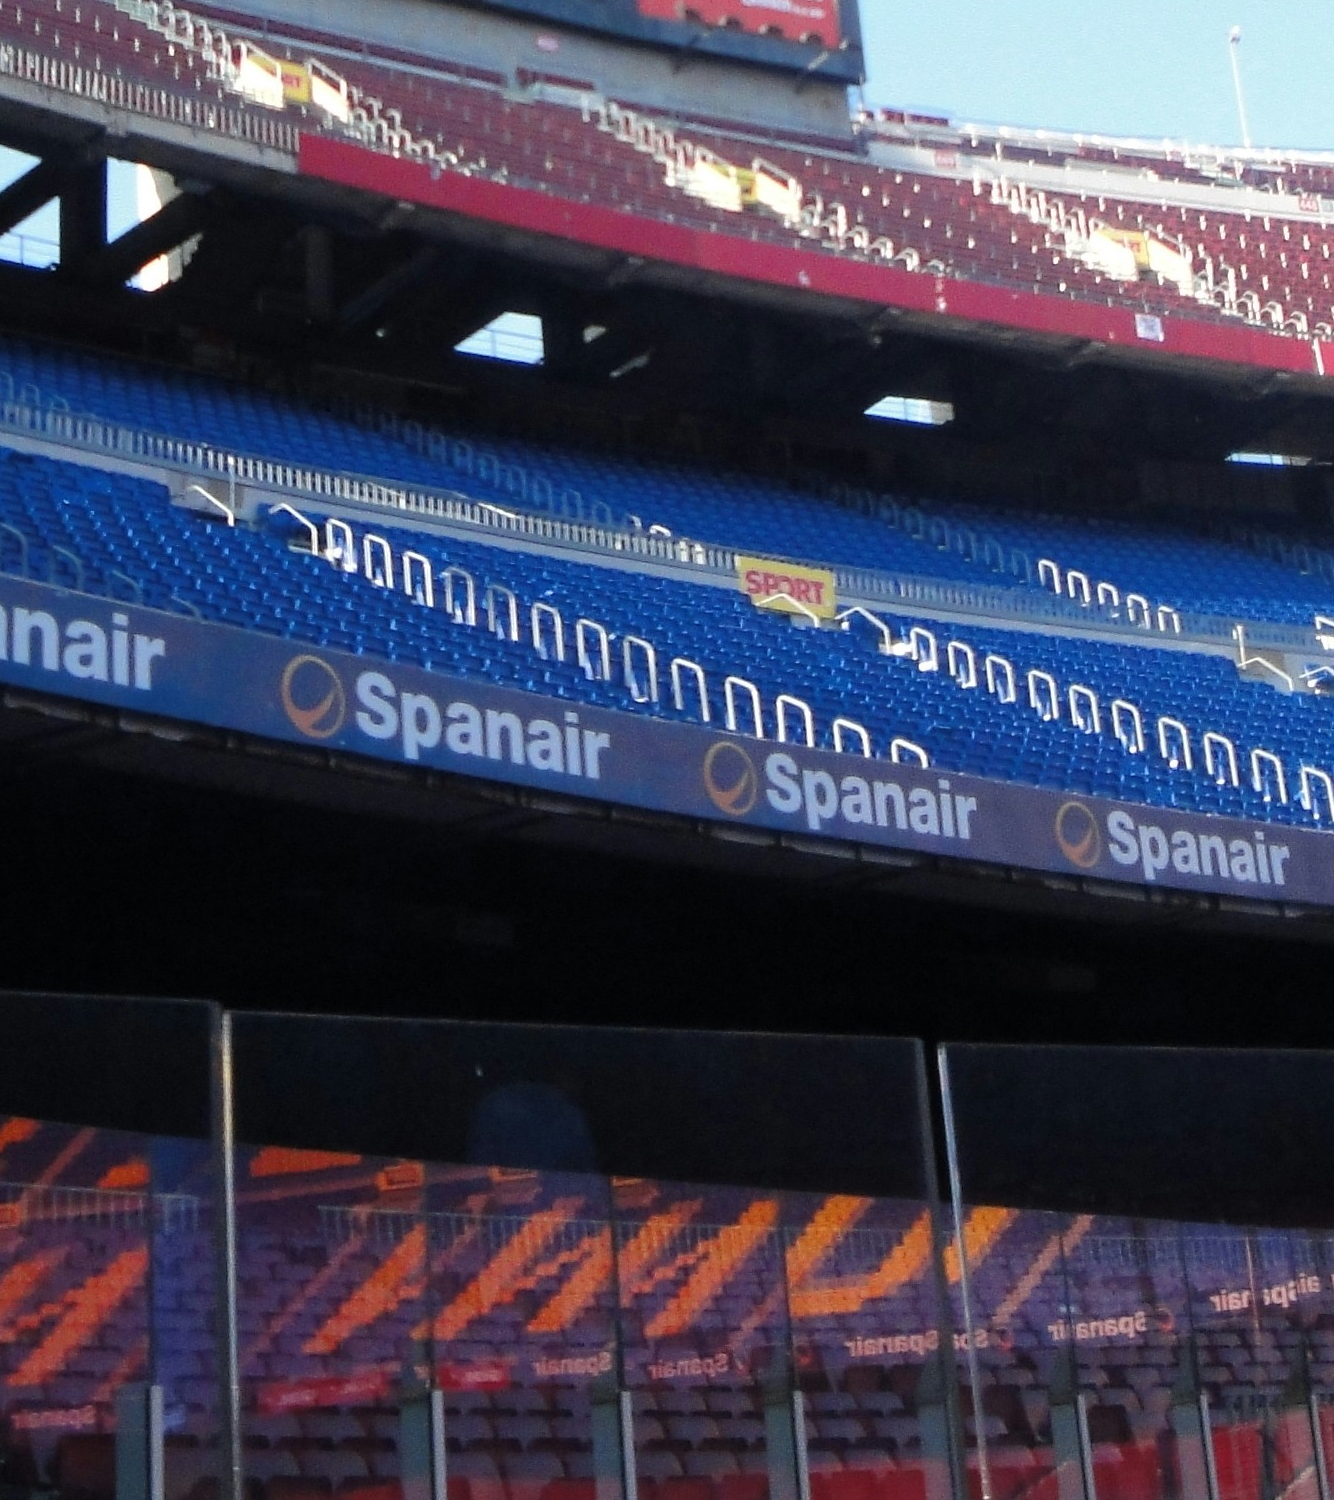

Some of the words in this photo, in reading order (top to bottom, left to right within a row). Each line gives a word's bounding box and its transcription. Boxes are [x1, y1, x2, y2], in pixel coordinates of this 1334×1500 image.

[744, 569, 825, 605] SPORT
[354, 671, 611, 780] Spanair
[765, 752, 977, 840] Spanair
[1106, 810, 1291, 886] Spanair
